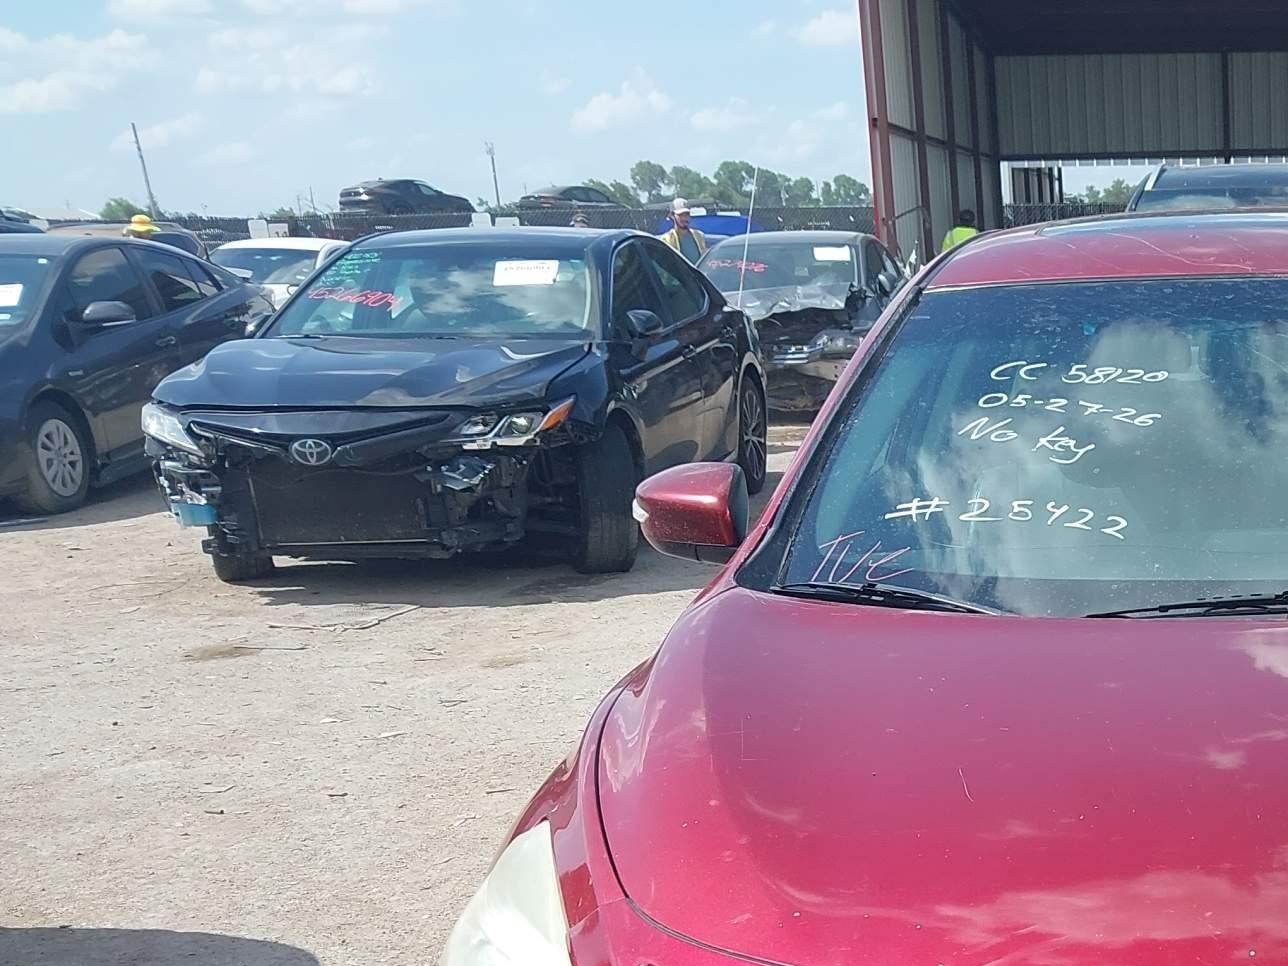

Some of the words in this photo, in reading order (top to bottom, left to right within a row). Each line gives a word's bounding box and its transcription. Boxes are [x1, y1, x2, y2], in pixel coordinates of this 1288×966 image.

[990, 361, 1047, 380] CC
[1062, 364, 1168, 384] 58120
[958, 416, 1018, 442] No
